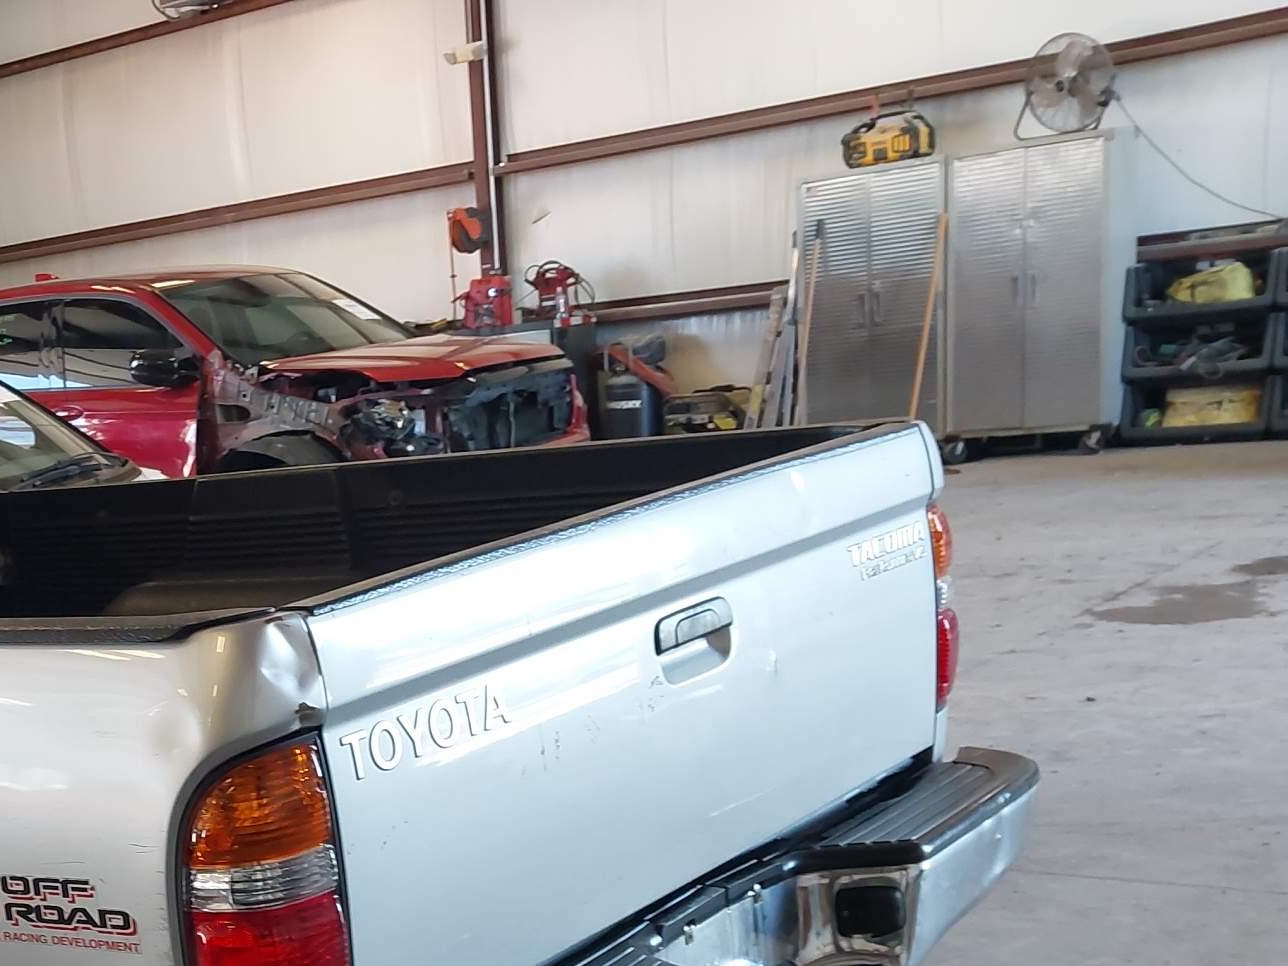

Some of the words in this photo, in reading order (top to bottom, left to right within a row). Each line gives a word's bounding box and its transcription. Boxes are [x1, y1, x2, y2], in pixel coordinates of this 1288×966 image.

[339, 684, 511, 780] TOYOTA
[0, 875, 96, 904] OFF
[4, 902, 137, 936] ROAD
[3, 931, 48, 944] RACING
[52, 935, 141, 953] DEVELOPMENT
